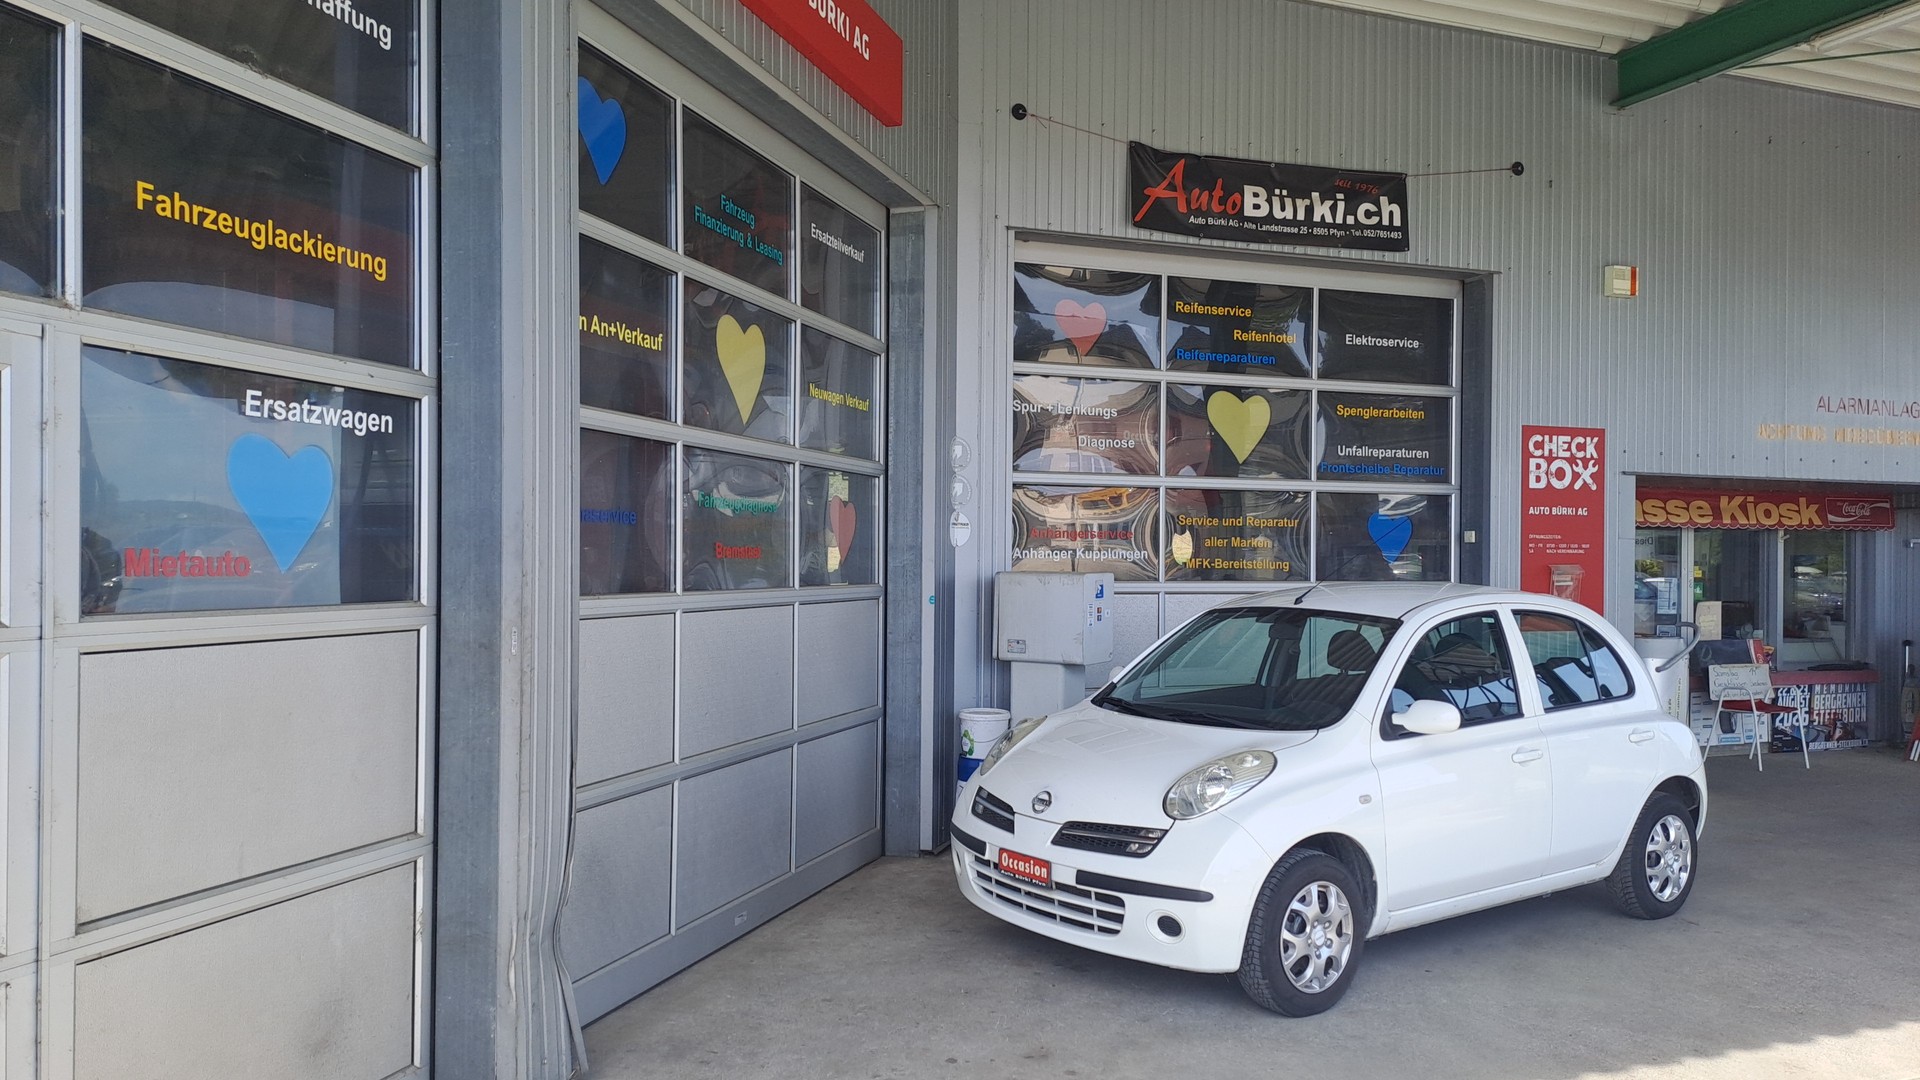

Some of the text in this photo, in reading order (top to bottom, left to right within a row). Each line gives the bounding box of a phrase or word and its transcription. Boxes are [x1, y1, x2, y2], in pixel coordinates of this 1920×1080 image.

[853, 25, 870, 61] AG
[1355, 182, 1378, 194] 1976
[721, 194, 755, 230] Fahrzeug
[136, 180, 388, 282] Fahrzeuglackierung
[694, 205, 784, 266] Finanzierung & Leasing
[1188, 215, 1206, 225] Auto
[1207, 217, 1228, 226] Bürki
[1228, 219, 1239, 228] AG
[1243, 221, 1257, 230] Alte
[1257, 222, 1299, 234] Landstrasse
[1299, 226, 1308, 234] 25
[1312, 227, 1329, 236] 8505
[1329, 228, 1346, 238] Pfyn
[811, 222, 865, 264] Ersatzteilverkauf
[1175, 301, 1252, 317] Reifenservice
[590, 314, 664, 352] An+Verkauf
[1233, 329, 1297, 344] Reifenhotel
[1345, 333, 1420, 349] Elektroservice
[1176, 348, 1276, 364] Reifenreparaturen
[809, 382, 870, 412] Neuwagen Verkauf
[244, 388, 393, 437] Ersatzwagen
[1012, 399, 1041, 415] Spur
[1058, 402, 1118, 419] Lenkungs
[1336, 404, 1425, 419] Spenglerarbeiten
[1078, 435, 1135, 450] Diagnose
[1528, 434, 1599, 458] CHECK
[1337, 445, 1430, 459] Unfallreparaturen
[1528, 505, 1588, 516] AUTO BÜRKI AG
[1719, 494, 1823, 526] Kiosk
[1178, 514, 1300, 529] Service und Reparatur
[1029, 526, 1134, 541] Anhängerservice
[1204, 536, 1273, 548] aller Marken
[124, 547, 251, 578] Mietauto
[1012, 547, 1148, 561] Anhänger Kupplungen
[1186, 558, 1290, 572] MFK-Bereitstellung
[1814, 692, 1867, 710] BERGRENNEN
[1001, 852, 1048, 879] Occasion
